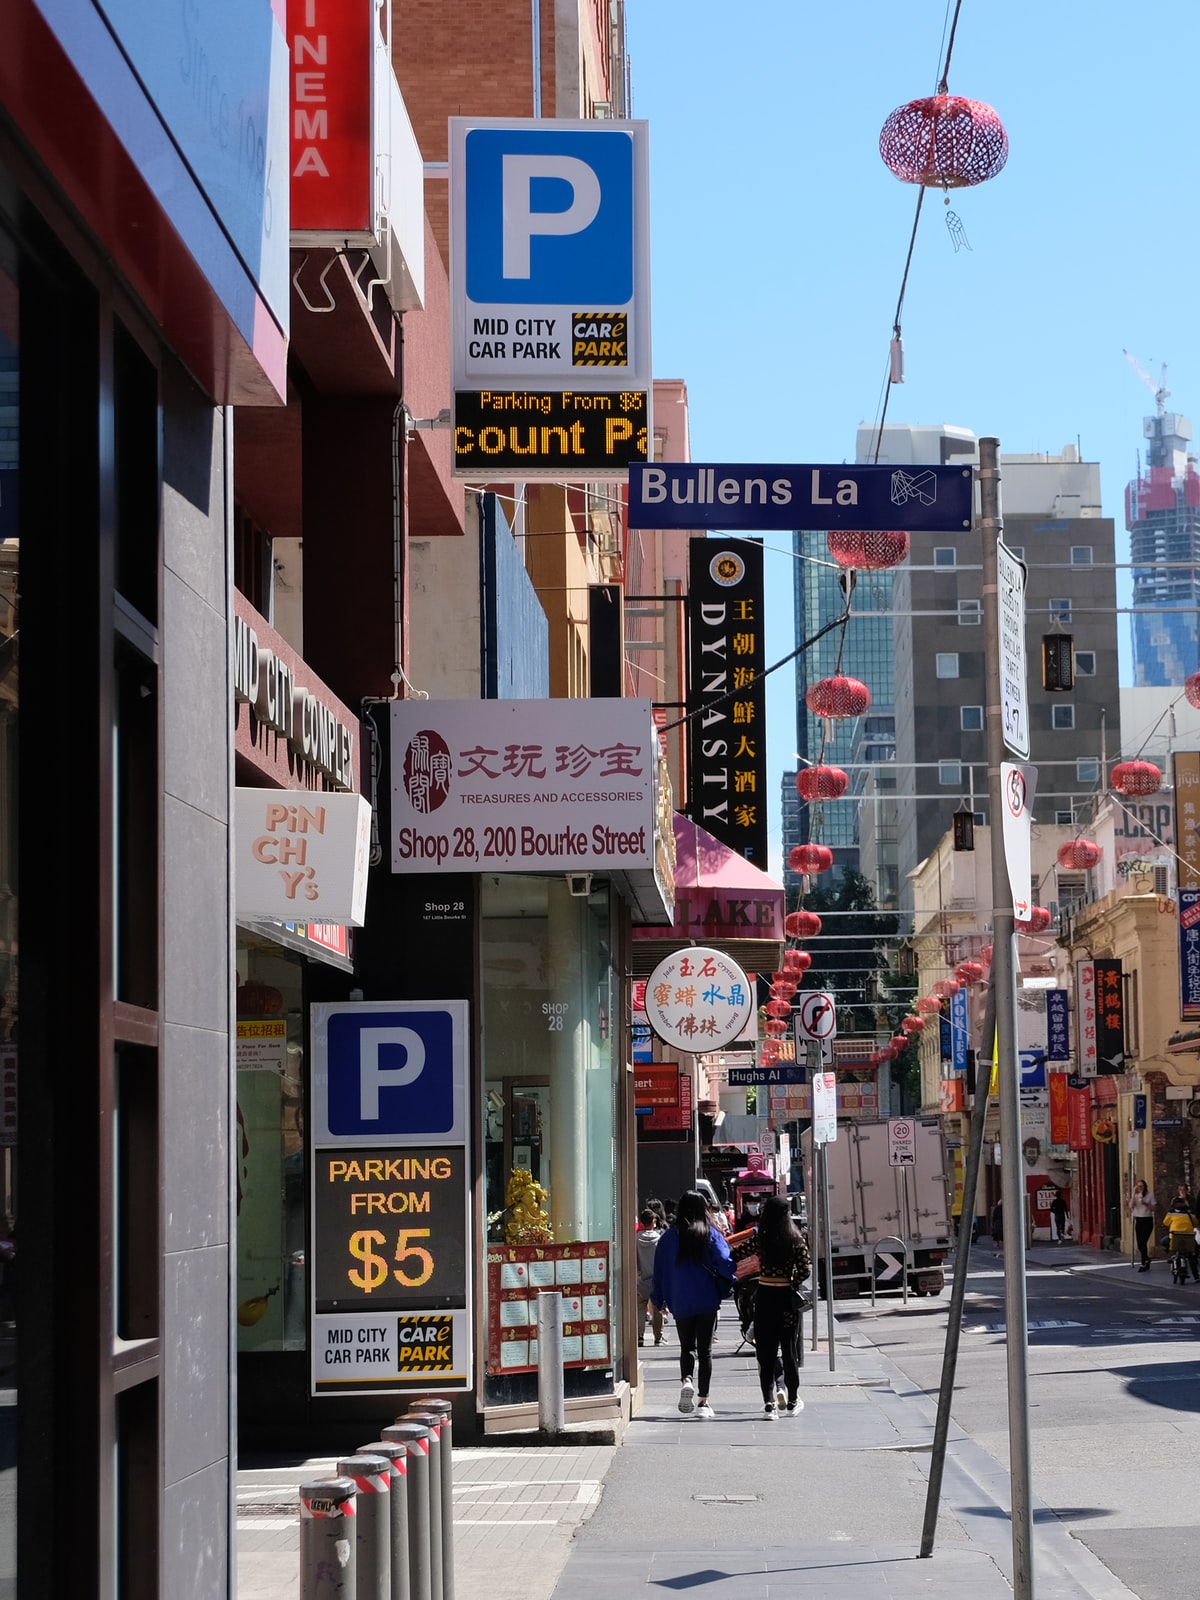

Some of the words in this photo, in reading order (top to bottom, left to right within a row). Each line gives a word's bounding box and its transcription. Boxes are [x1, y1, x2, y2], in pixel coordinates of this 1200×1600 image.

[502, 154, 601, 280] P
[473, 318, 509, 336] MID
[515, 319, 557, 336] CITY
[469, 341, 506, 359] CAR
[512, 342, 562, 359] PARK
[574, 341, 625, 356] PARK
[480, 391, 551, 414] Parking
[562, 391, 611, 410] From
[619, 392, 642, 412] $5
[454, 419, 585, 454] count
[641, 468, 792, 505] Bullens
[811, 470, 859, 505] La
[701, 600, 728, 825] DYNASTY
[732, 598, 757, 827] 王朝海鮮大酒家
[460, 794, 531, 804] TREASURES
[533, 793, 559, 803] AND
[561, 792, 643, 802] ACCESSORIES
[252, 836, 307, 866] CH
[399, 828, 449, 865] Shop
[452, 827, 480, 863] 28,
[483, 826, 516, 857] 200
[521, 825, 588, 857] Bourke
[592, 824, 646, 855] Street
[425, 902, 450, 912] Shop
[452, 902, 464, 911] 28
[677, 899, 775, 926] LAKE
[679, 957, 717, 978] 玉石
[717, 962, 737, 981] Crystal
[702, 983, 745, 1007] 水晶
[541, 1003, 569, 1014] SHOP
[548, 1015, 563, 1031] 28
[658, 1009, 673, 1030] Amber
[675, 1013, 721, 1040] 佛珠
[954, 993, 965, 1065] POKIES
[360, 1027, 426, 1121] P
[731, 1070, 765, 1083] Hughs
[681, 1076, 690, 1108] DRAGON
[681, 1110, 691, 1128] BOAT
[896, 1127, 907, 1135] 20
[329, 1157, 452, 1183] PARKING
[351, 1192, 431, 1214] FROM
[348, 1228, 434, 1293] $5
[487, 1253, 502, 1263] 2020
[327, 1329, 354, 1344] MID
[358, 1328, 387, 1344] CITY
[325, 1348, 352, 1364] CAR
[357, 1348, 391, 1364] PARK
[399, 1346, 450, 1362] PARK
